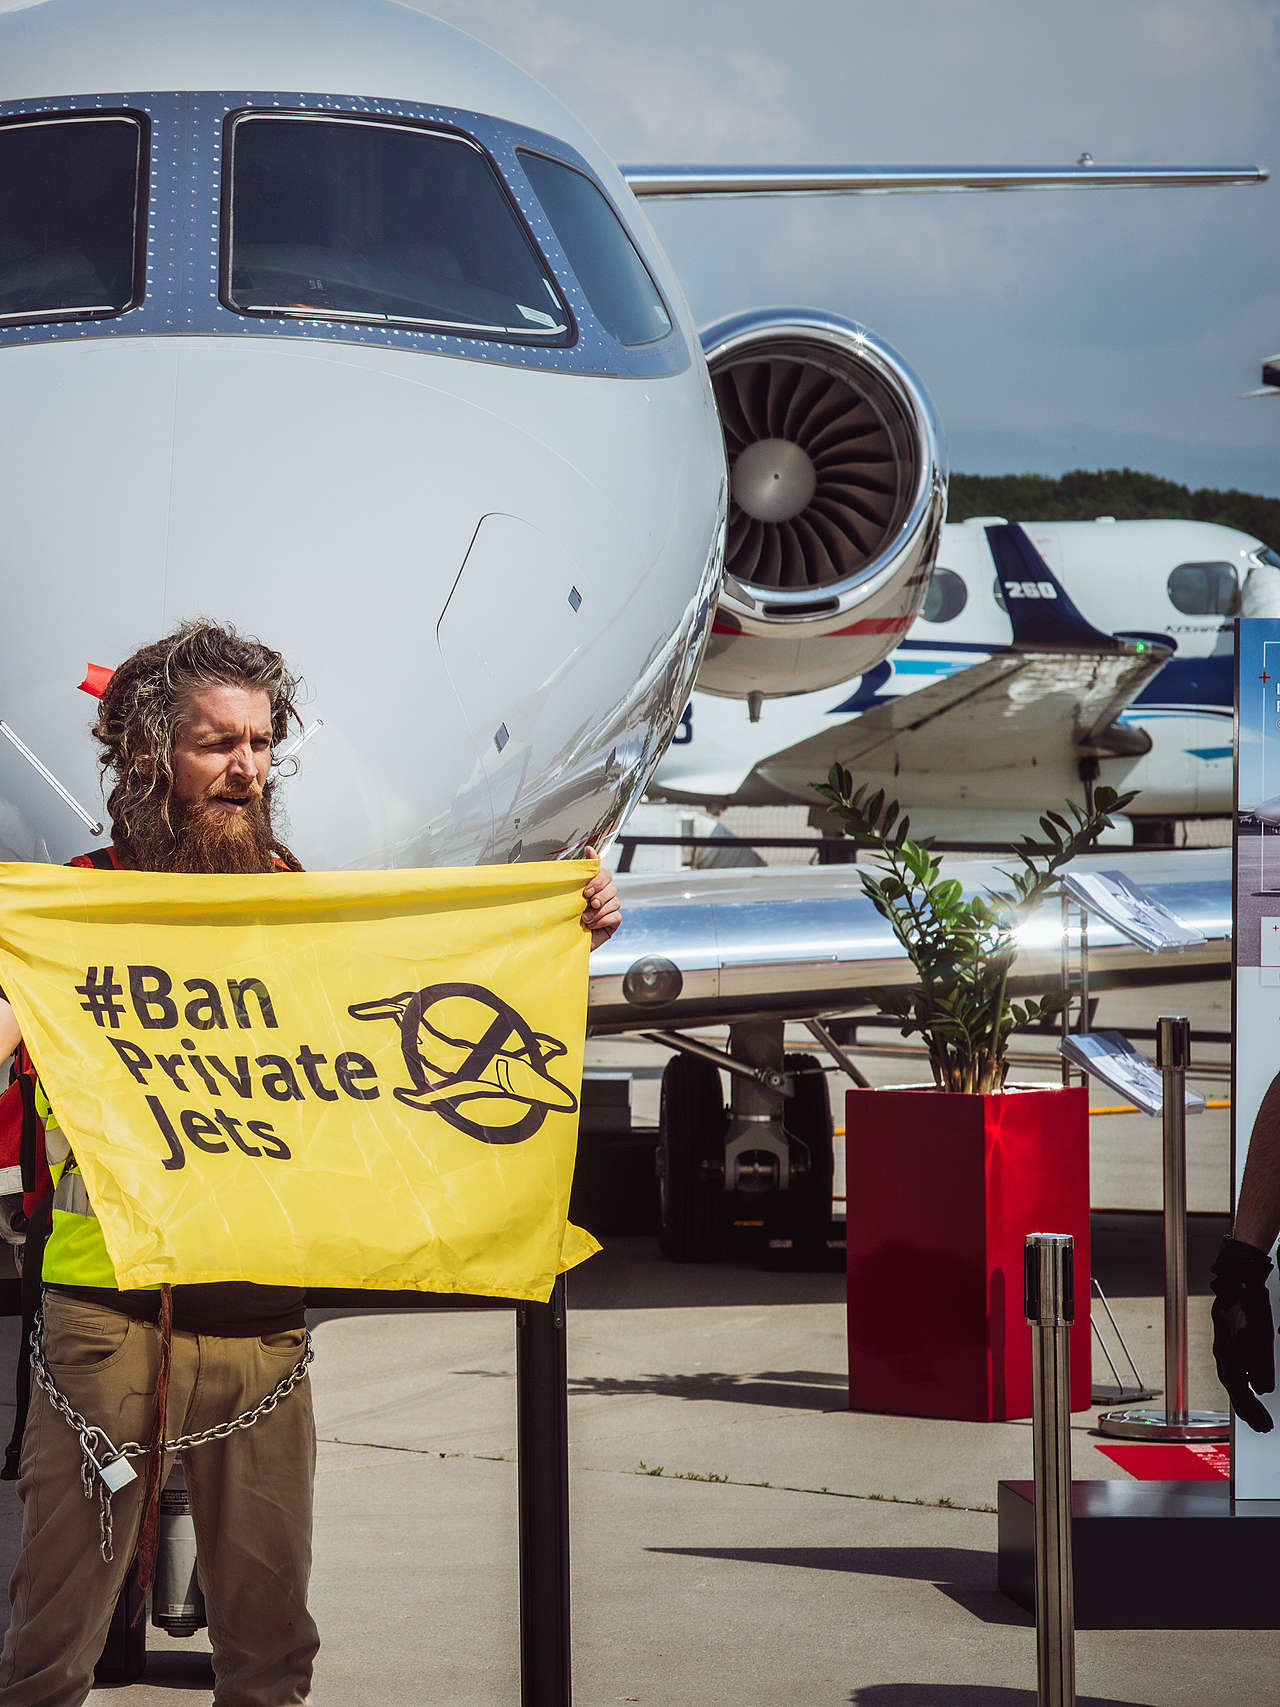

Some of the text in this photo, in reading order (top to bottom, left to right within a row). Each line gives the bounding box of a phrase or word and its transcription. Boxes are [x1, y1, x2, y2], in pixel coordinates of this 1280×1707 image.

[1004, 581, 1058, 599] 260
[75, 965, 279, 1030] #Ban
[106, 1036, 381, 1102] Private
[144, 1095, 292, 1171] Jets
